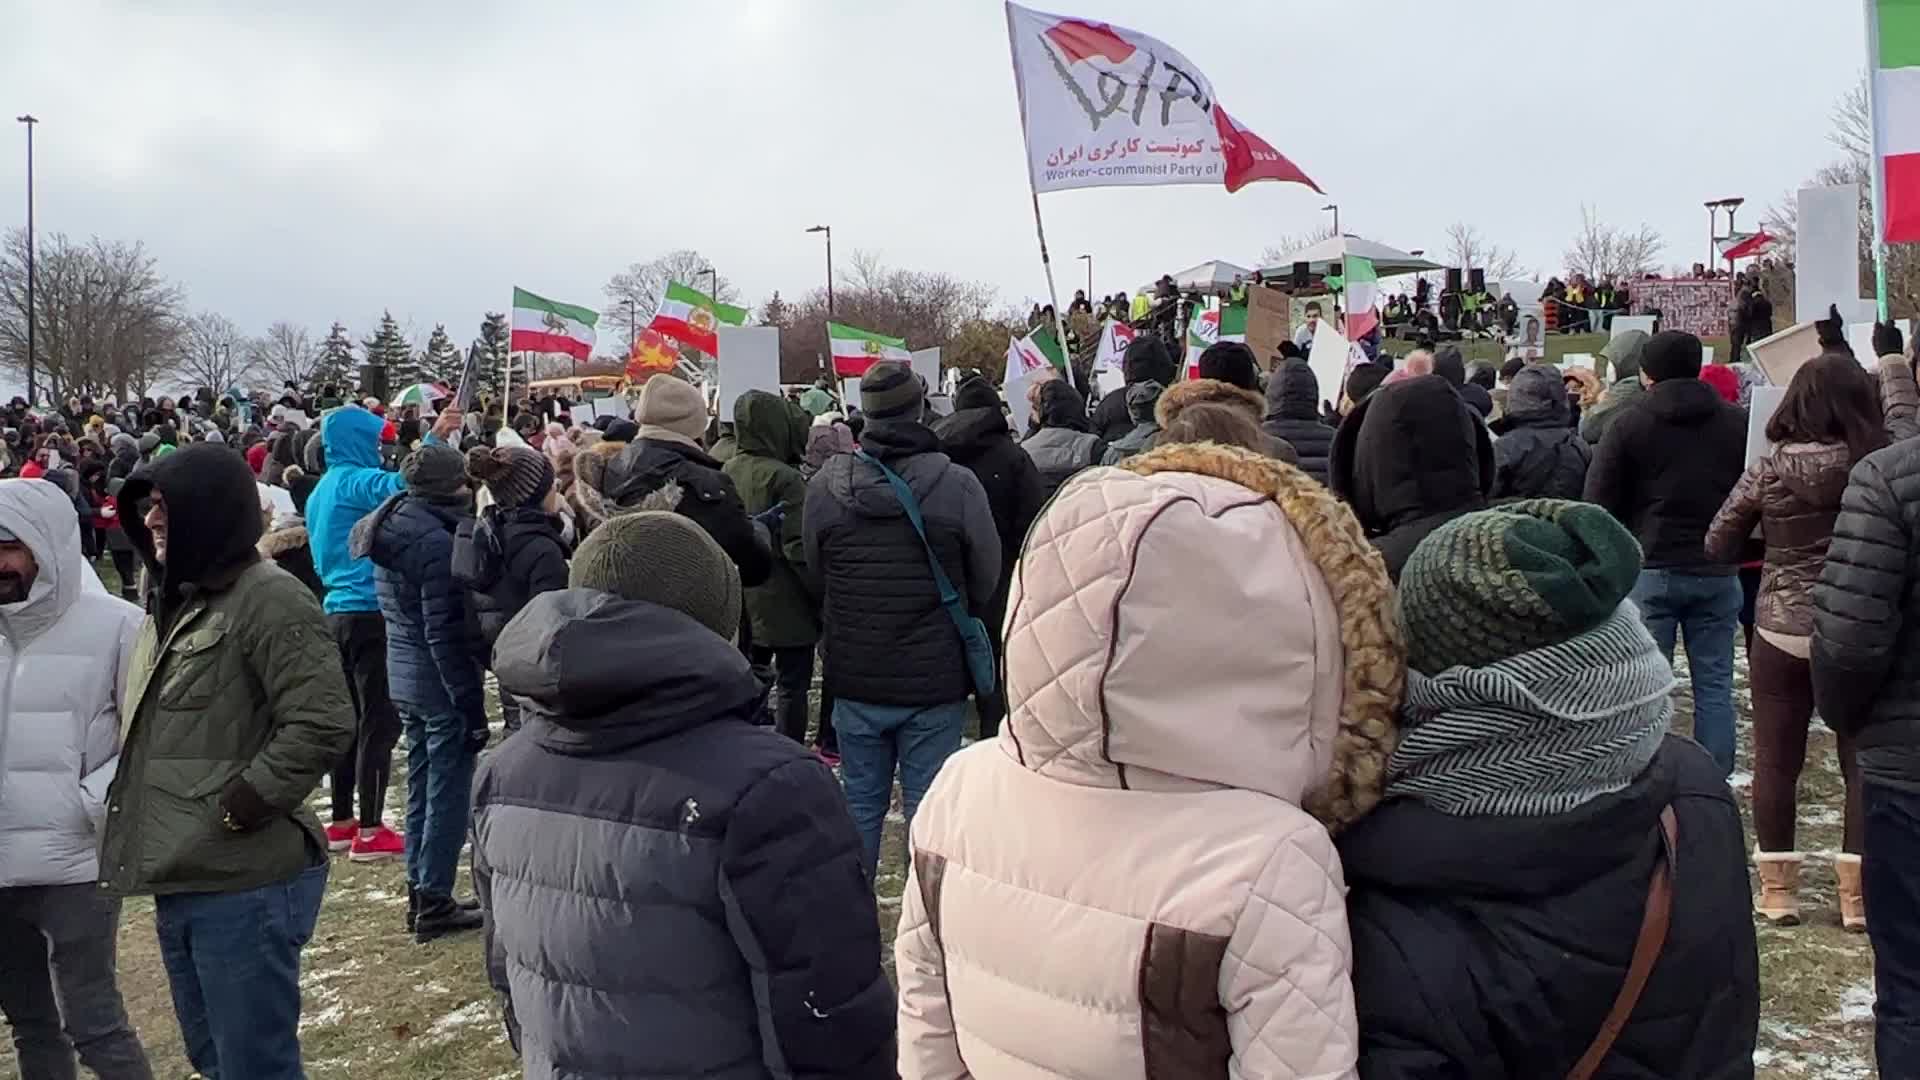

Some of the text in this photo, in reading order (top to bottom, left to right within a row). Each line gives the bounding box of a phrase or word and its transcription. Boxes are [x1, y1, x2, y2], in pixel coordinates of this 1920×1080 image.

[1046, 162, 1167, 180] Worker-communist
[1170, 163, 1201, 176] Party
[1205, 163, 1218, 174] of
